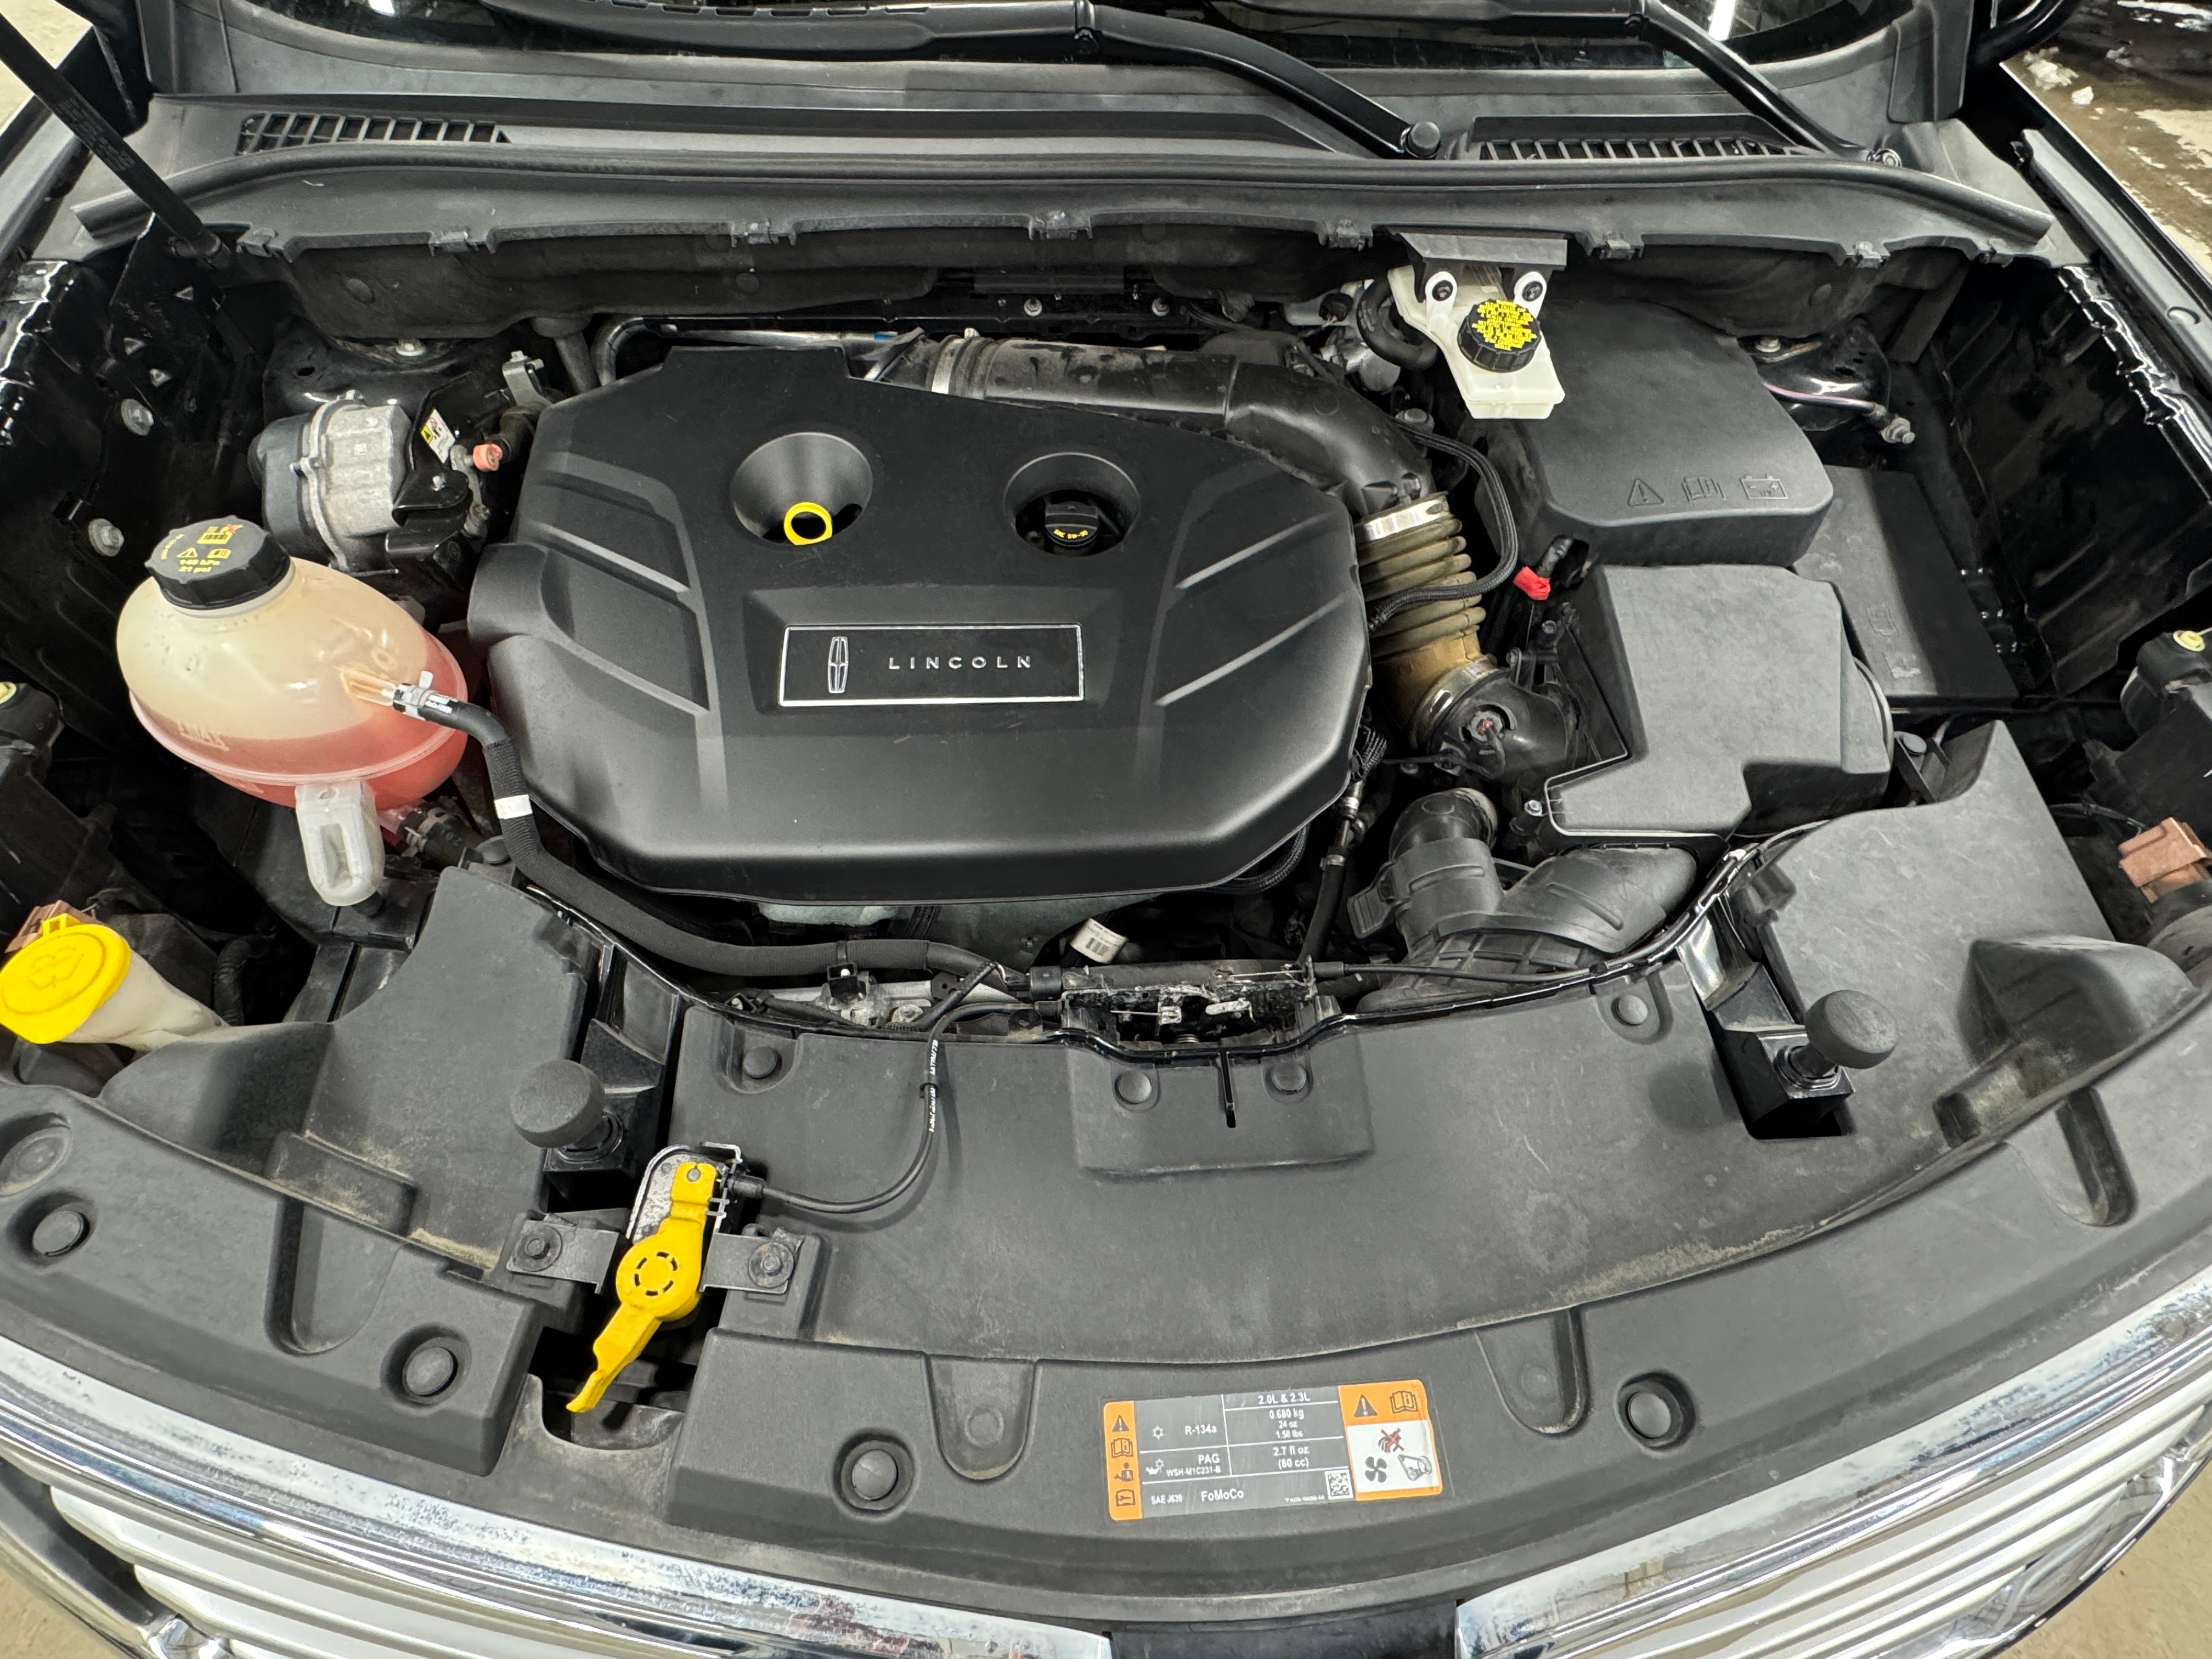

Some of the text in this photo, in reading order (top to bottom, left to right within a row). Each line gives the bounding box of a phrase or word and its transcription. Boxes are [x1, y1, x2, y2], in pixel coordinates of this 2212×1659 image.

[889, 656, 1031, 669] LINCOLN
[1258, 1392, 1311, 1404] 2.0L & 2.3L
[1269, 1408, 1304, 1419] 0.680 kg
[1185, 1424, 1217, 1435] R-134a
[1279, 1420, 1287, 1429] 24
[1276, 1430, 1290, 1438] 1.50
[1273, 1445, 1310, 1457] 2.7 fl oz
[1198, 1454, 1220, 1464] PAG
[1278, 1457, 1309, 1470] (80 cc)
[1166, 1465, 1221, 1477] WSH-M1C231-B
[1151, 1494, 1166, 1504] SAE
[1201, 1488, 1244, 1502] FoMoCo
